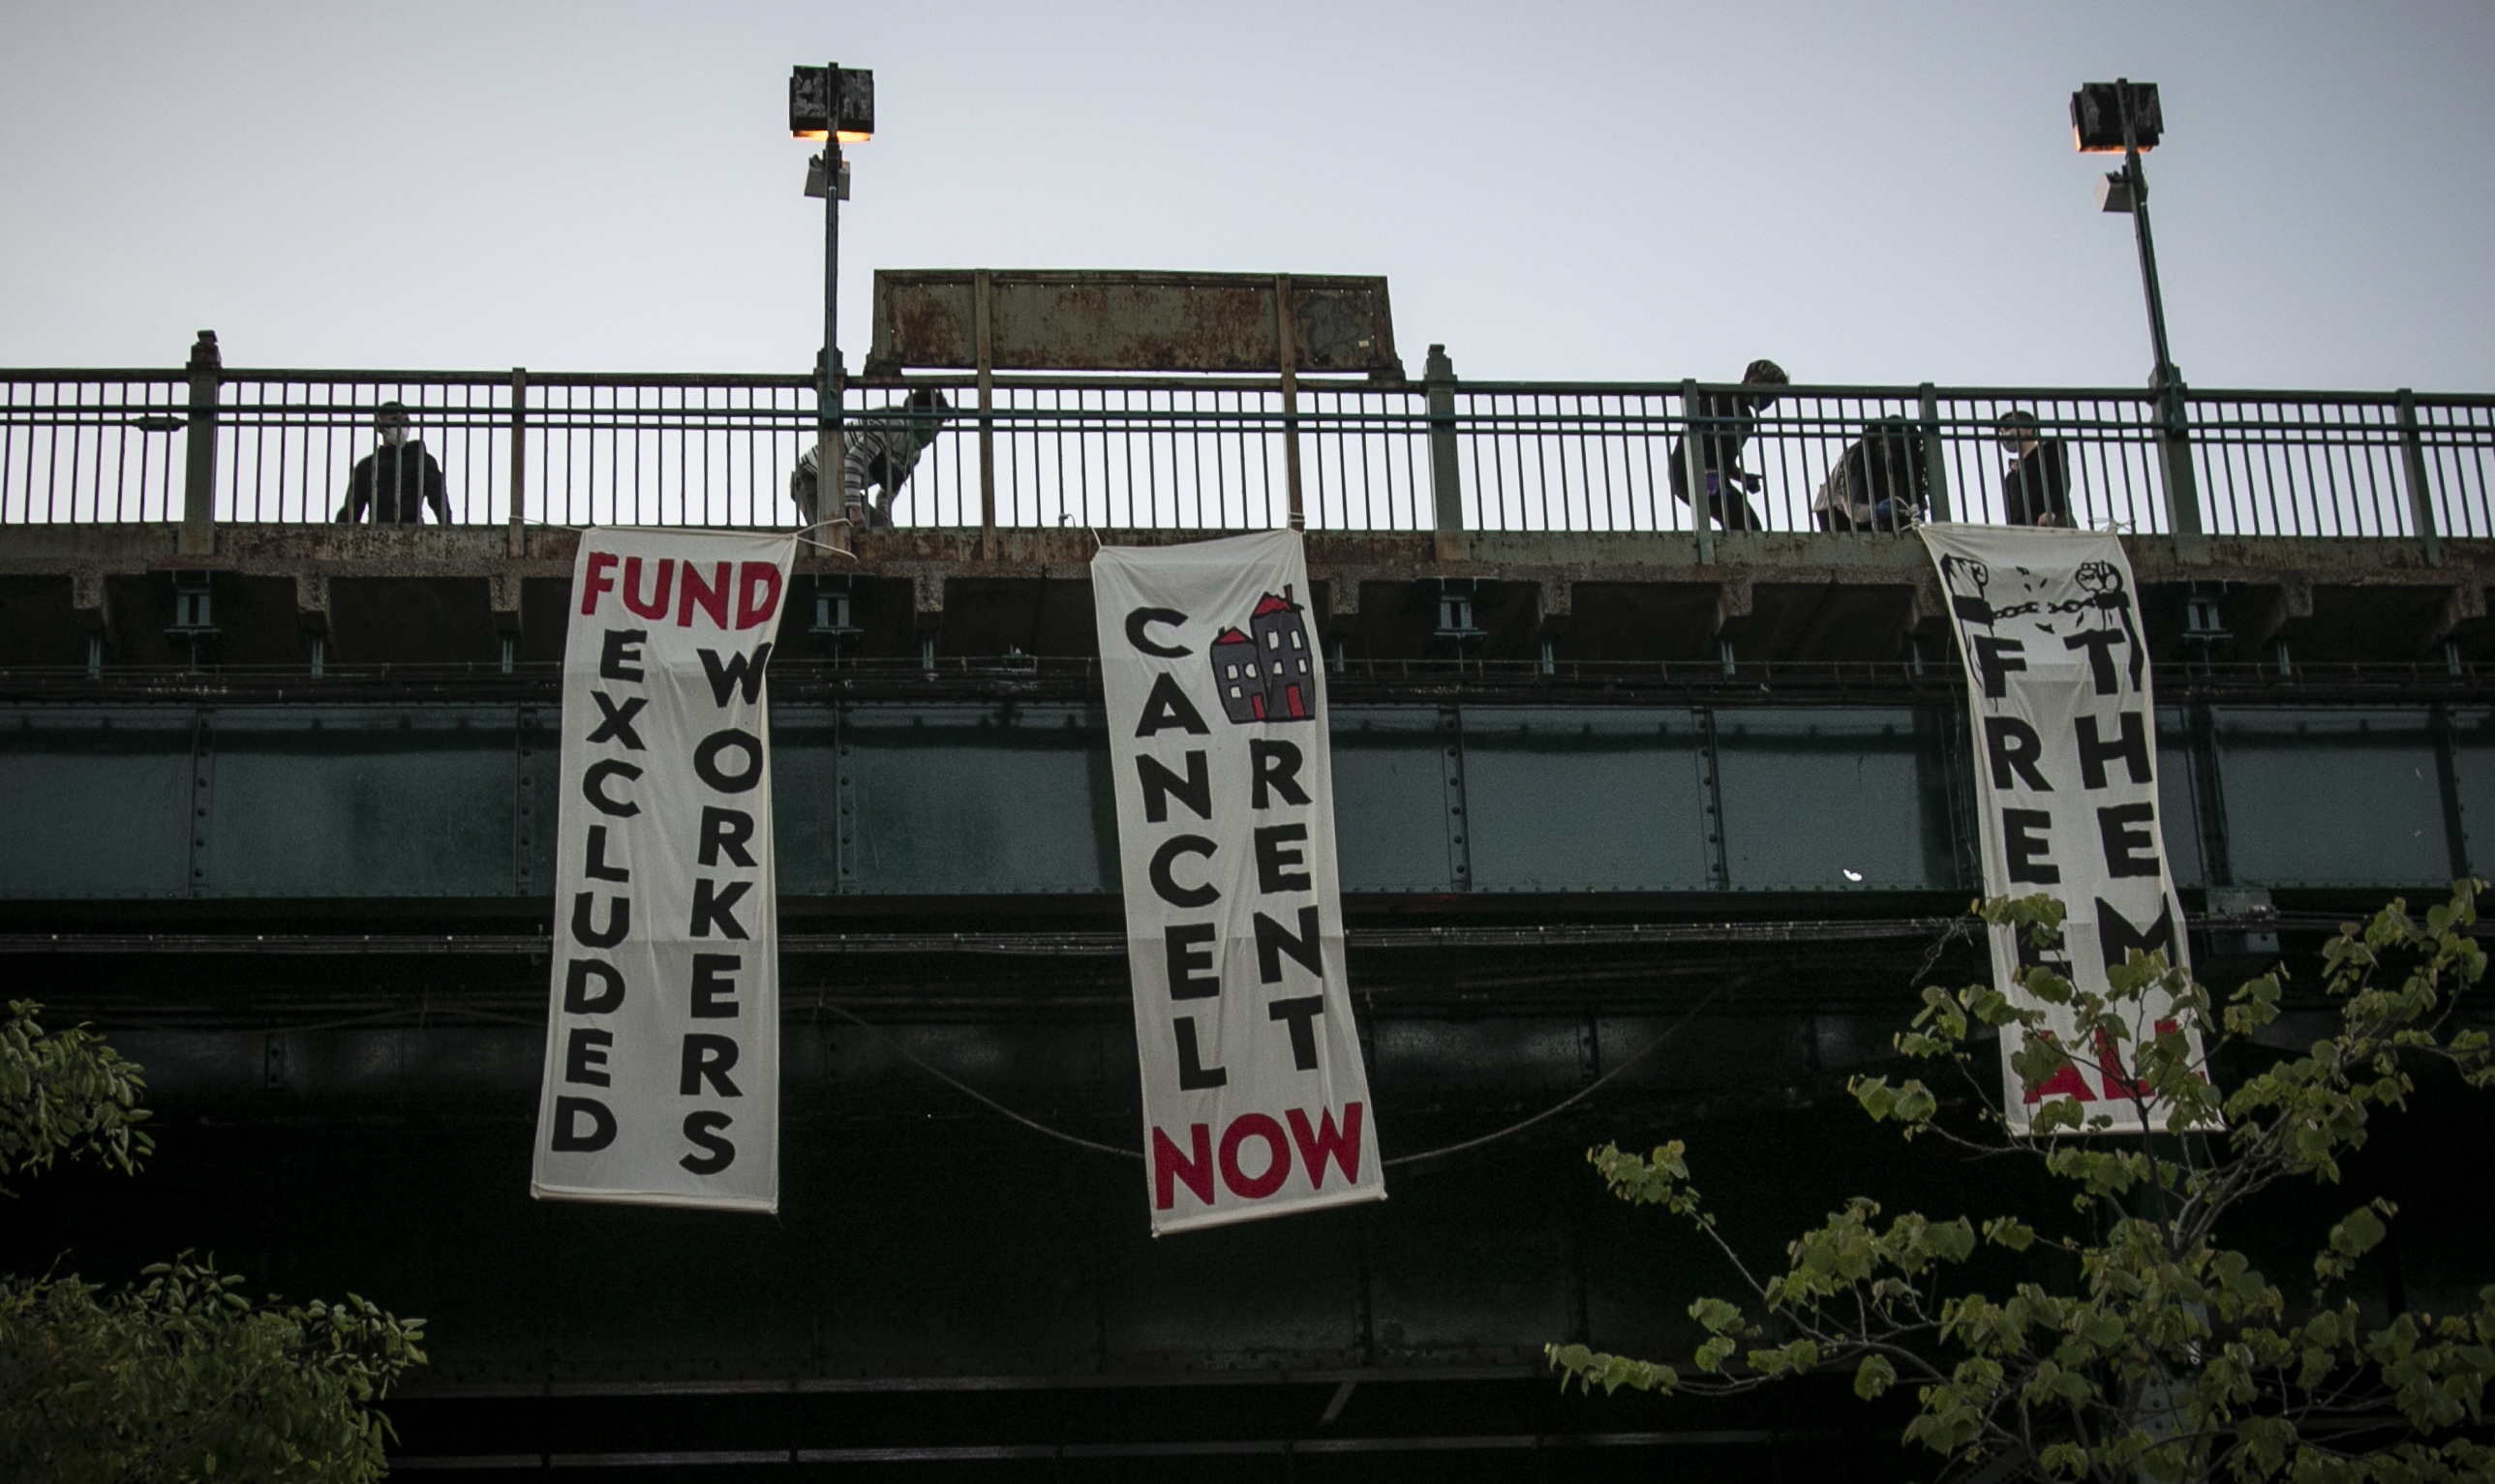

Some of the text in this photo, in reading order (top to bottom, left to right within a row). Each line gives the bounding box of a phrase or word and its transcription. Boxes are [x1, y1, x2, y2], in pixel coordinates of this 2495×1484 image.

[581, 551, 783, 630] FUND
[552, 629, 649, 1152] EXCLUDED
[679, 642, 774, 1175] WORKERS
[1125, 607, 1228, 1091] CANCEL
[1251, 738, 1324, 1072] RENT
[1973, 634, 2073, 981] FREE
[2062, 628, 2177, 976] THEM
[1152, 1102, 1363, 1210] NOW
